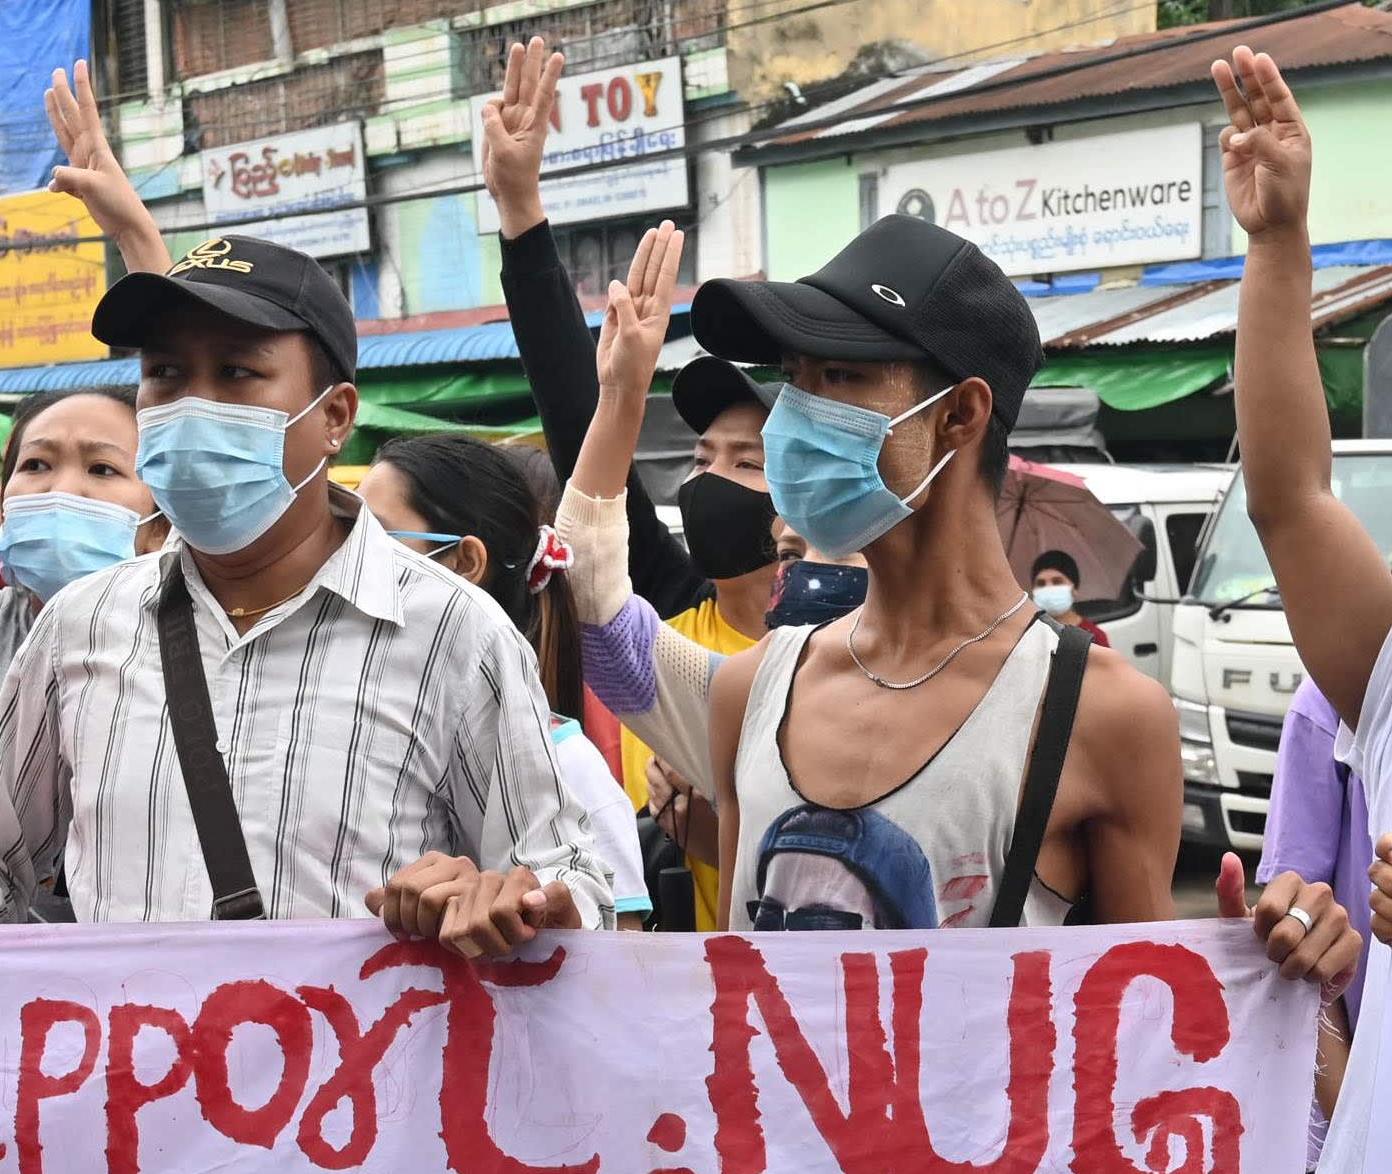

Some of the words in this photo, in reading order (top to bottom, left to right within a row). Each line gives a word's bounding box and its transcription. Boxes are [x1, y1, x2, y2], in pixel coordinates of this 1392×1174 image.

[580, 71, 664, 128] TOY
[1041, 178, 1192, 218] Kitchenware
[1222, 667, 1302, 694] FU
